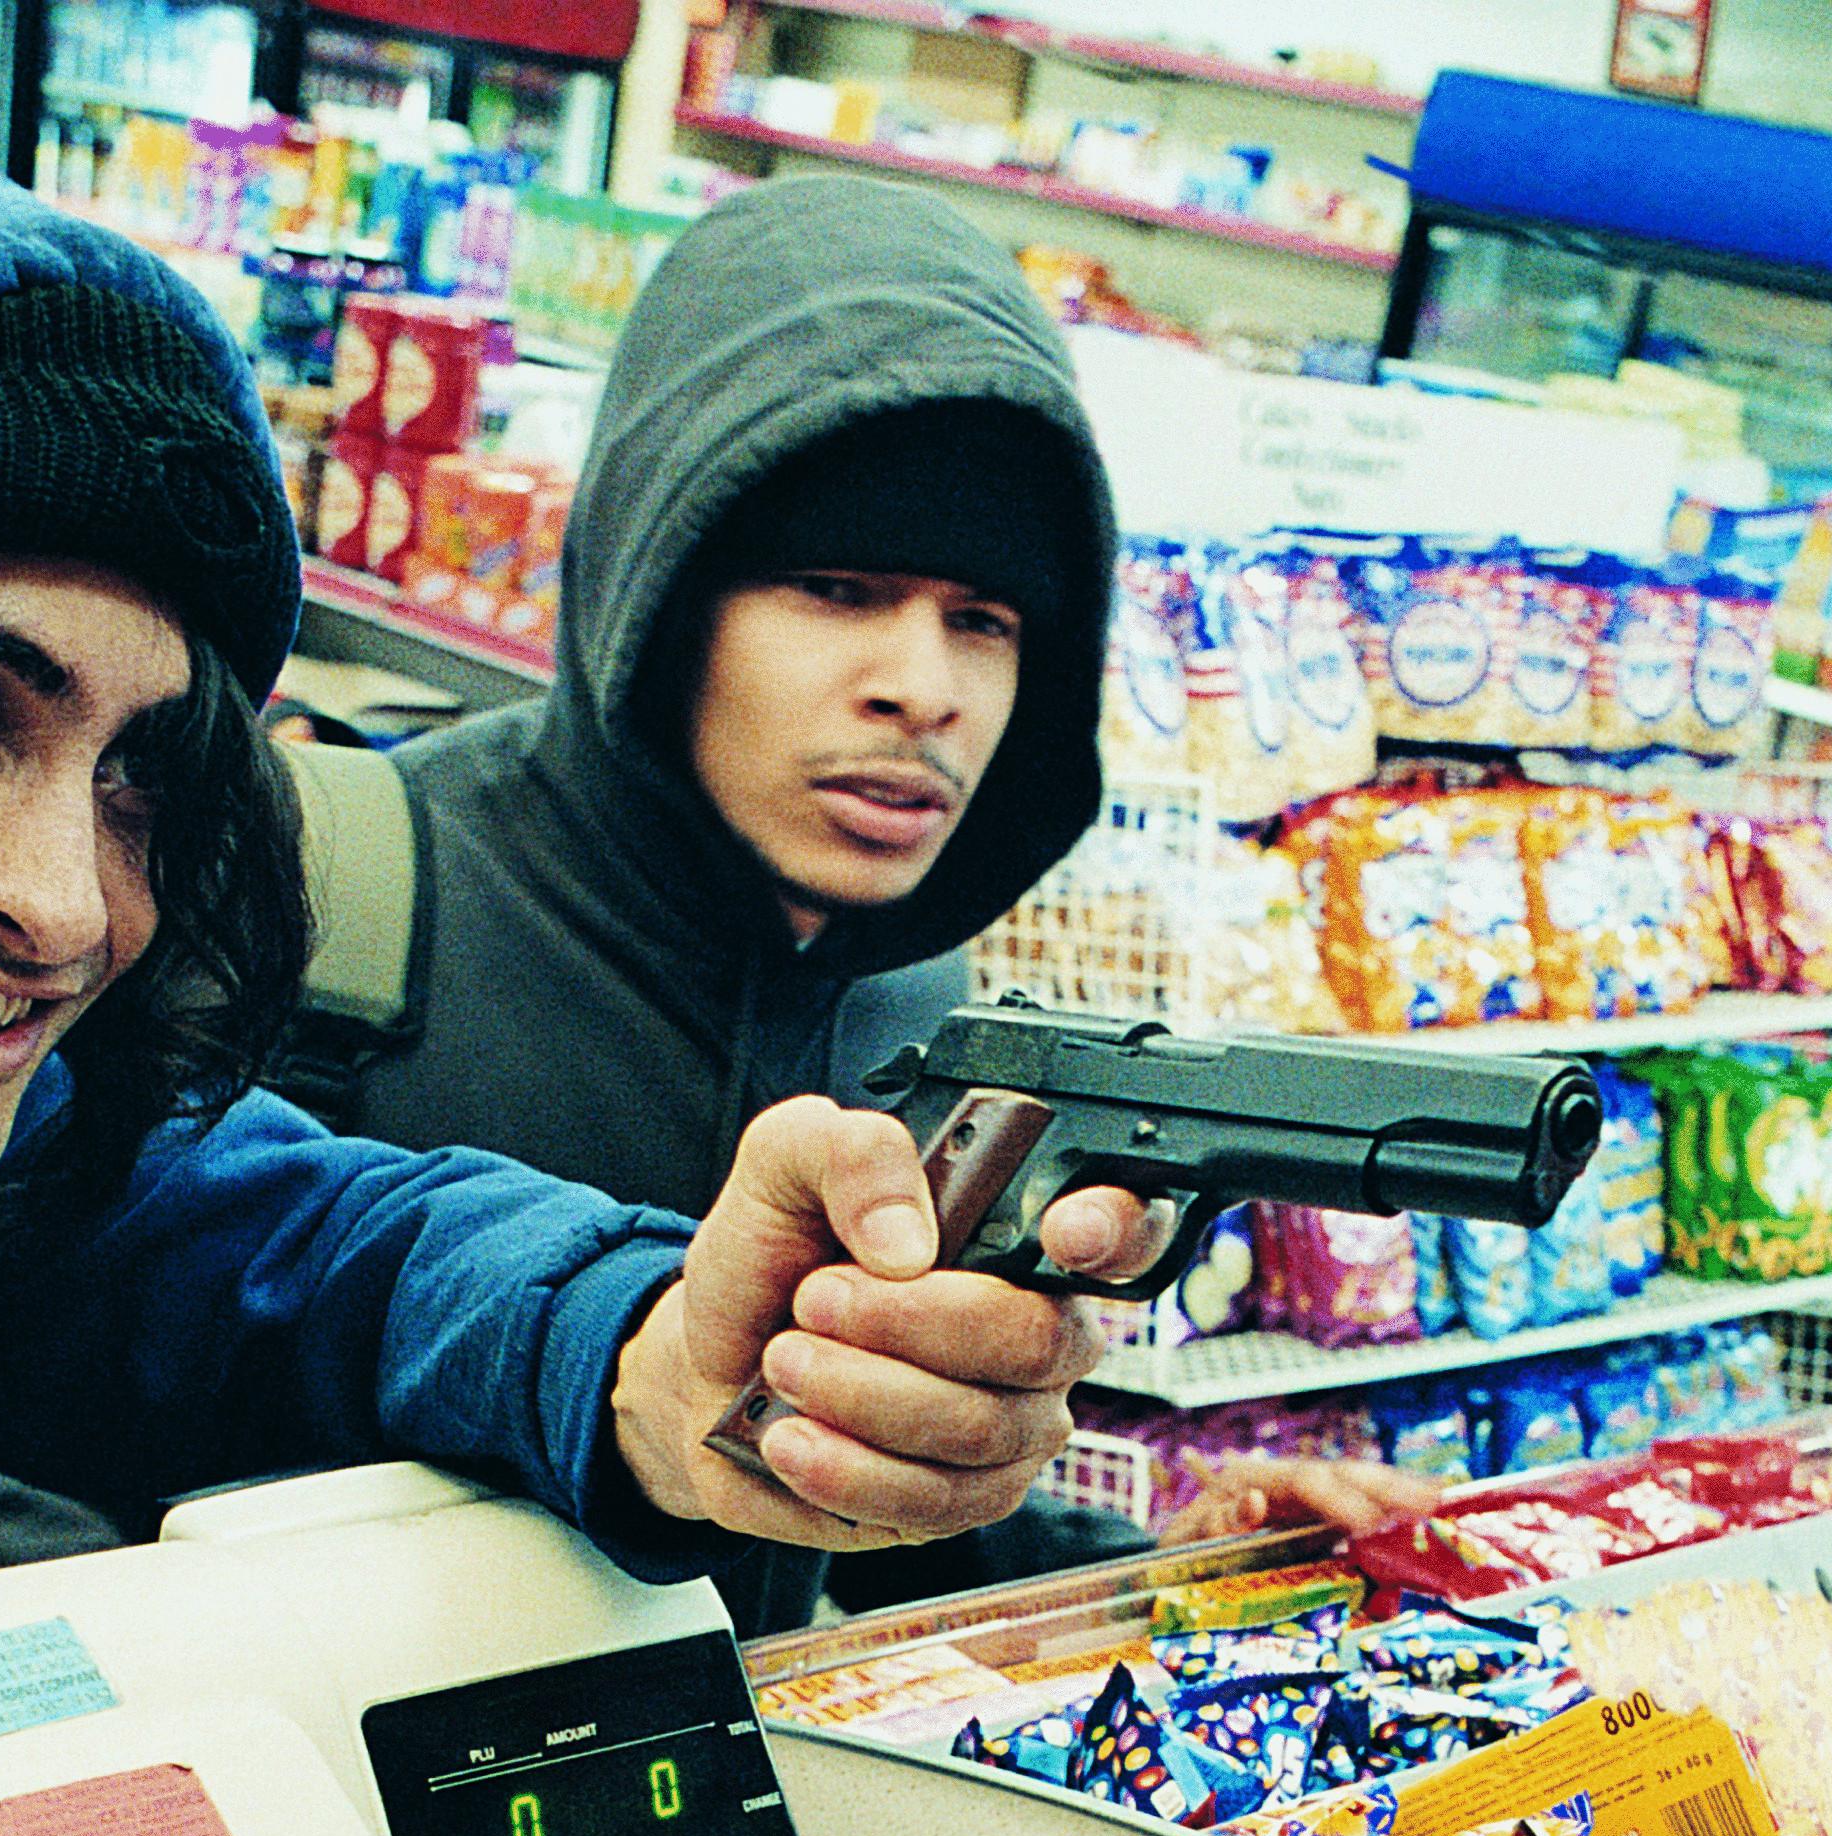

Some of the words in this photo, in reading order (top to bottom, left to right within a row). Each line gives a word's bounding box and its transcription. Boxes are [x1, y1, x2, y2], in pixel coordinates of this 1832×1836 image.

[546, 1723, 597, 1746] AMOUNT
[727, 1720, 758, 1735] TOTAL
[469, 1747, 495, 1763] PLU
[650, 1758, 680, 1818] 0
[742, 1791, 782, 1813] CHANGE
